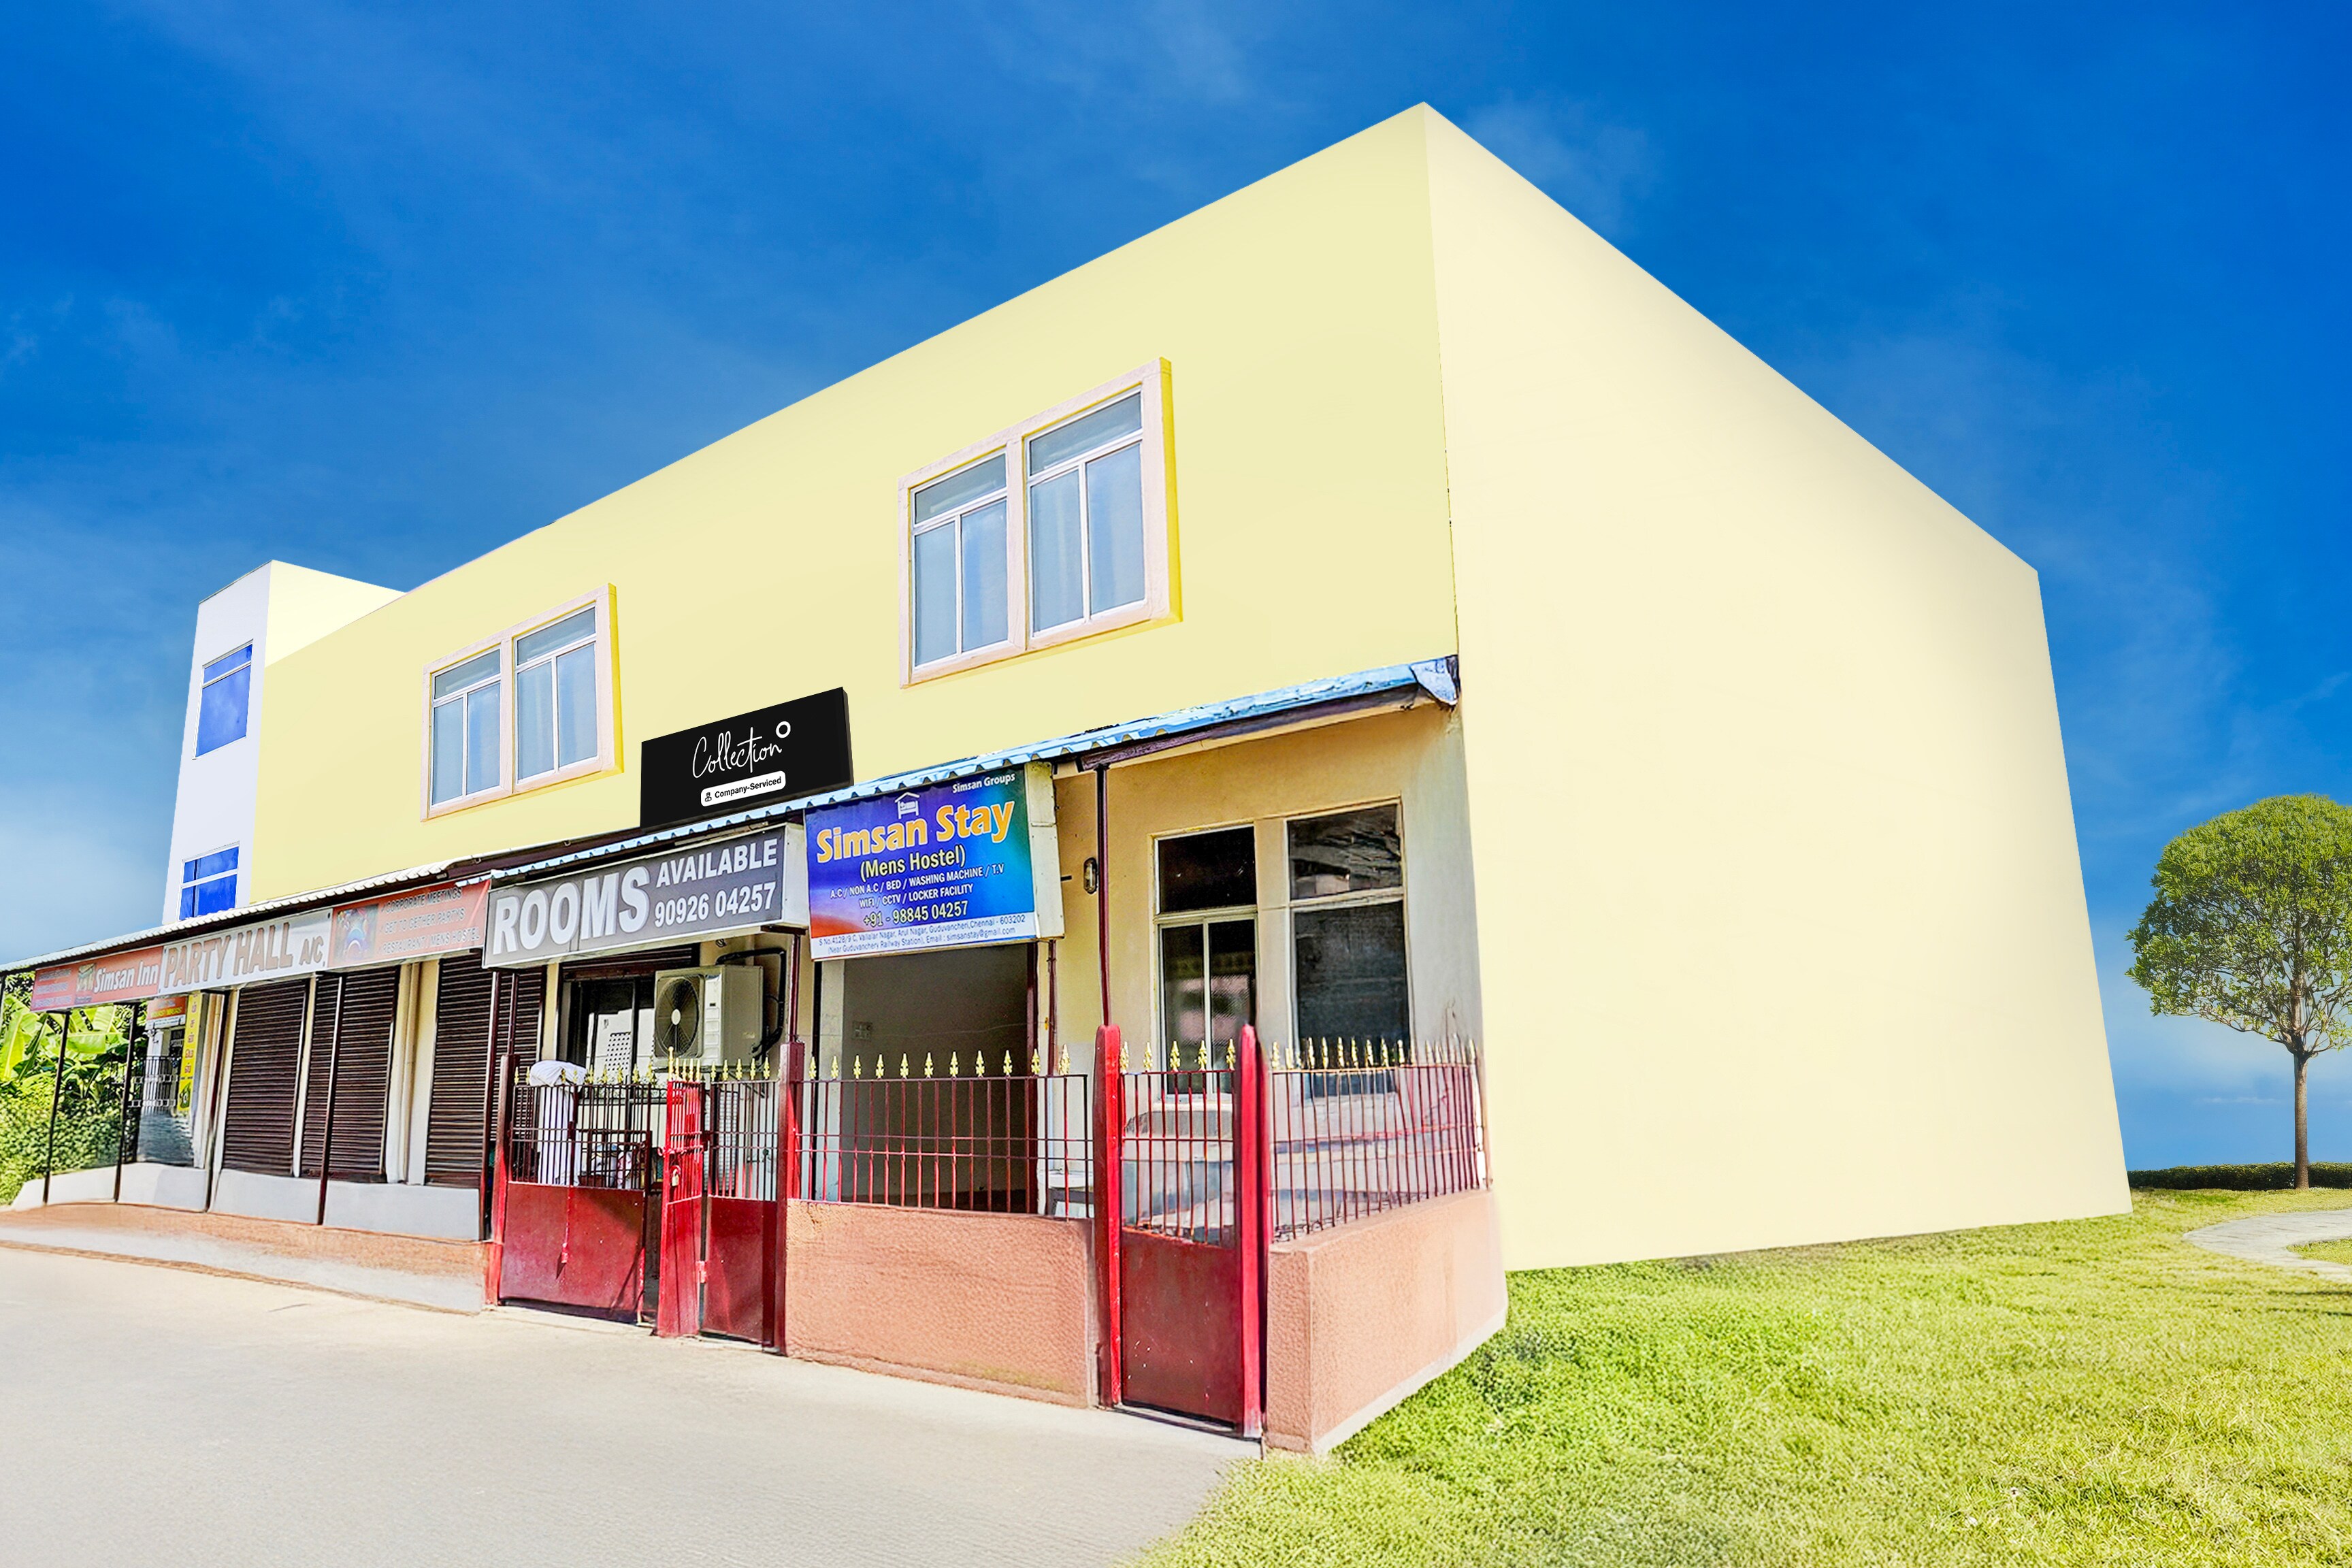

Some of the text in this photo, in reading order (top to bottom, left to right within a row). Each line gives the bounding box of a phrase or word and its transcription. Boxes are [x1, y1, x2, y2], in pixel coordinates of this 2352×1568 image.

[692, 726, 783, 779] Collection
[714, 776, 782, 799] Company-Serviced
[953, 773, 1015, 794] Simsan Groups
[817, 800, 1015, 864] Simsan Stay
[860, 845, 966, 883] (Mens Hostel)
[493, 838, 778, 956] ROOMS AVAILABLE
[830, 889, 843, 900] A.C
[849, 884, 865, 896] NON
[866, 883, 879, 894] A.C
[886, 881, 902, 891] BED
[909, 873, 945, 887] WASHING
[946, 867, 983, 881] MACHINE
[992, 864, 1005, 875] T.V
[859, 898, 875, 909] WIFI
[882, 893, 901, 906] CCTV
[909, 888, 938, 902] LOCKER
[940, 883, 974, 898] FACILITY
[386, 887, 462, 913] CORPORATE MEETINGS
[654, 882, 777, 928] 90926 04257
[864, 911, 883, 928] +91
[892, 904, 929, 925] 98845
[930, 900, 968, 919] 04257
[999, 914, 1026, 926] 603202
[164, 922, 325, 988] PARTY HALL A/C
[93, 967, 135, 994] Simsan
[137, 961, 159, 987] Inn
